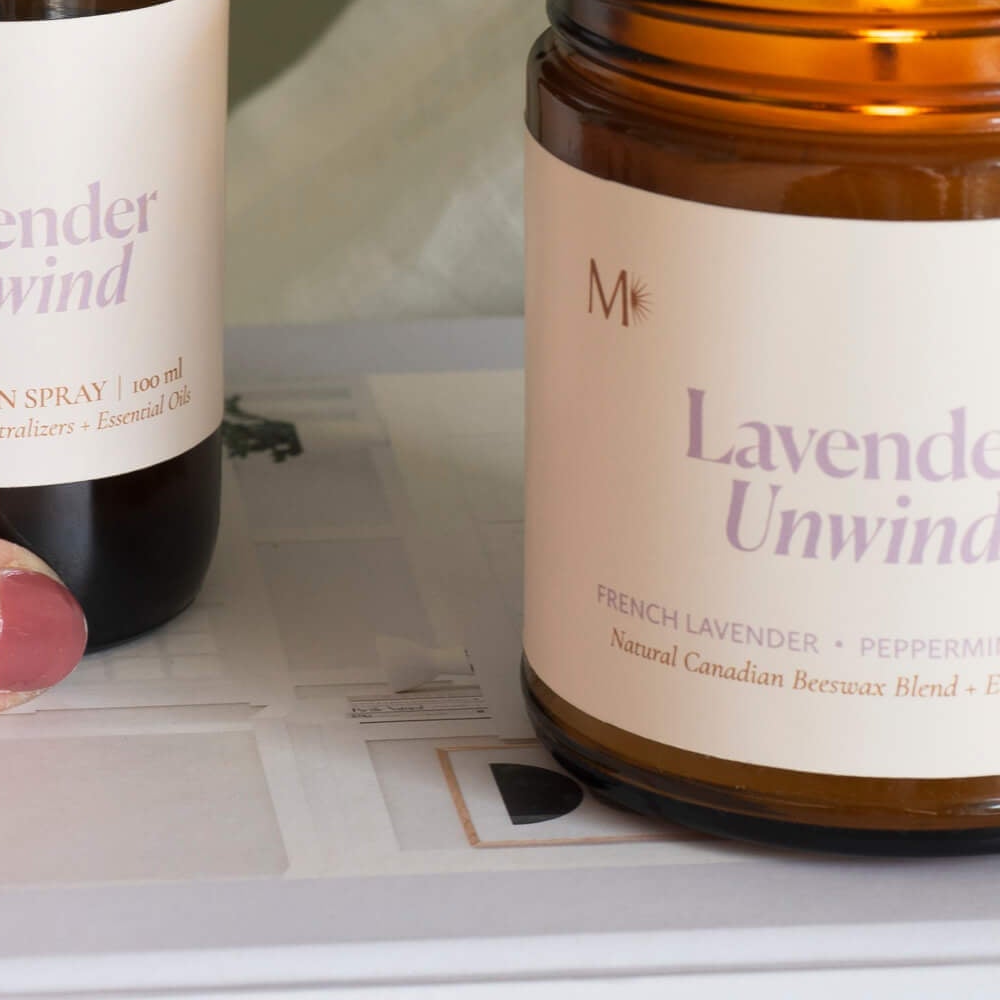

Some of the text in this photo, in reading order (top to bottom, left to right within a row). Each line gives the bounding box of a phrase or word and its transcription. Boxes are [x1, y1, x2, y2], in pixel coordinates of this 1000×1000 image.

[24, 380, 107, 409] SPRAY
[131, 373, 161, 394] 100
[163, 356, 183, 385] ml
[96, 393, 165, 431] Essential
[167, 384, 192, 411] Oils
[725, 479, 1000, 566] Unwind
[596, 583, 1000, 660] FRENCH LAVENDER PEPPERMI
[609, 626, 678, 668] Natural
[683, 650, 785, 689] Canadian
[791, 668, 887, 698] Beeswax
[894, 673, 960, 698] Blend
